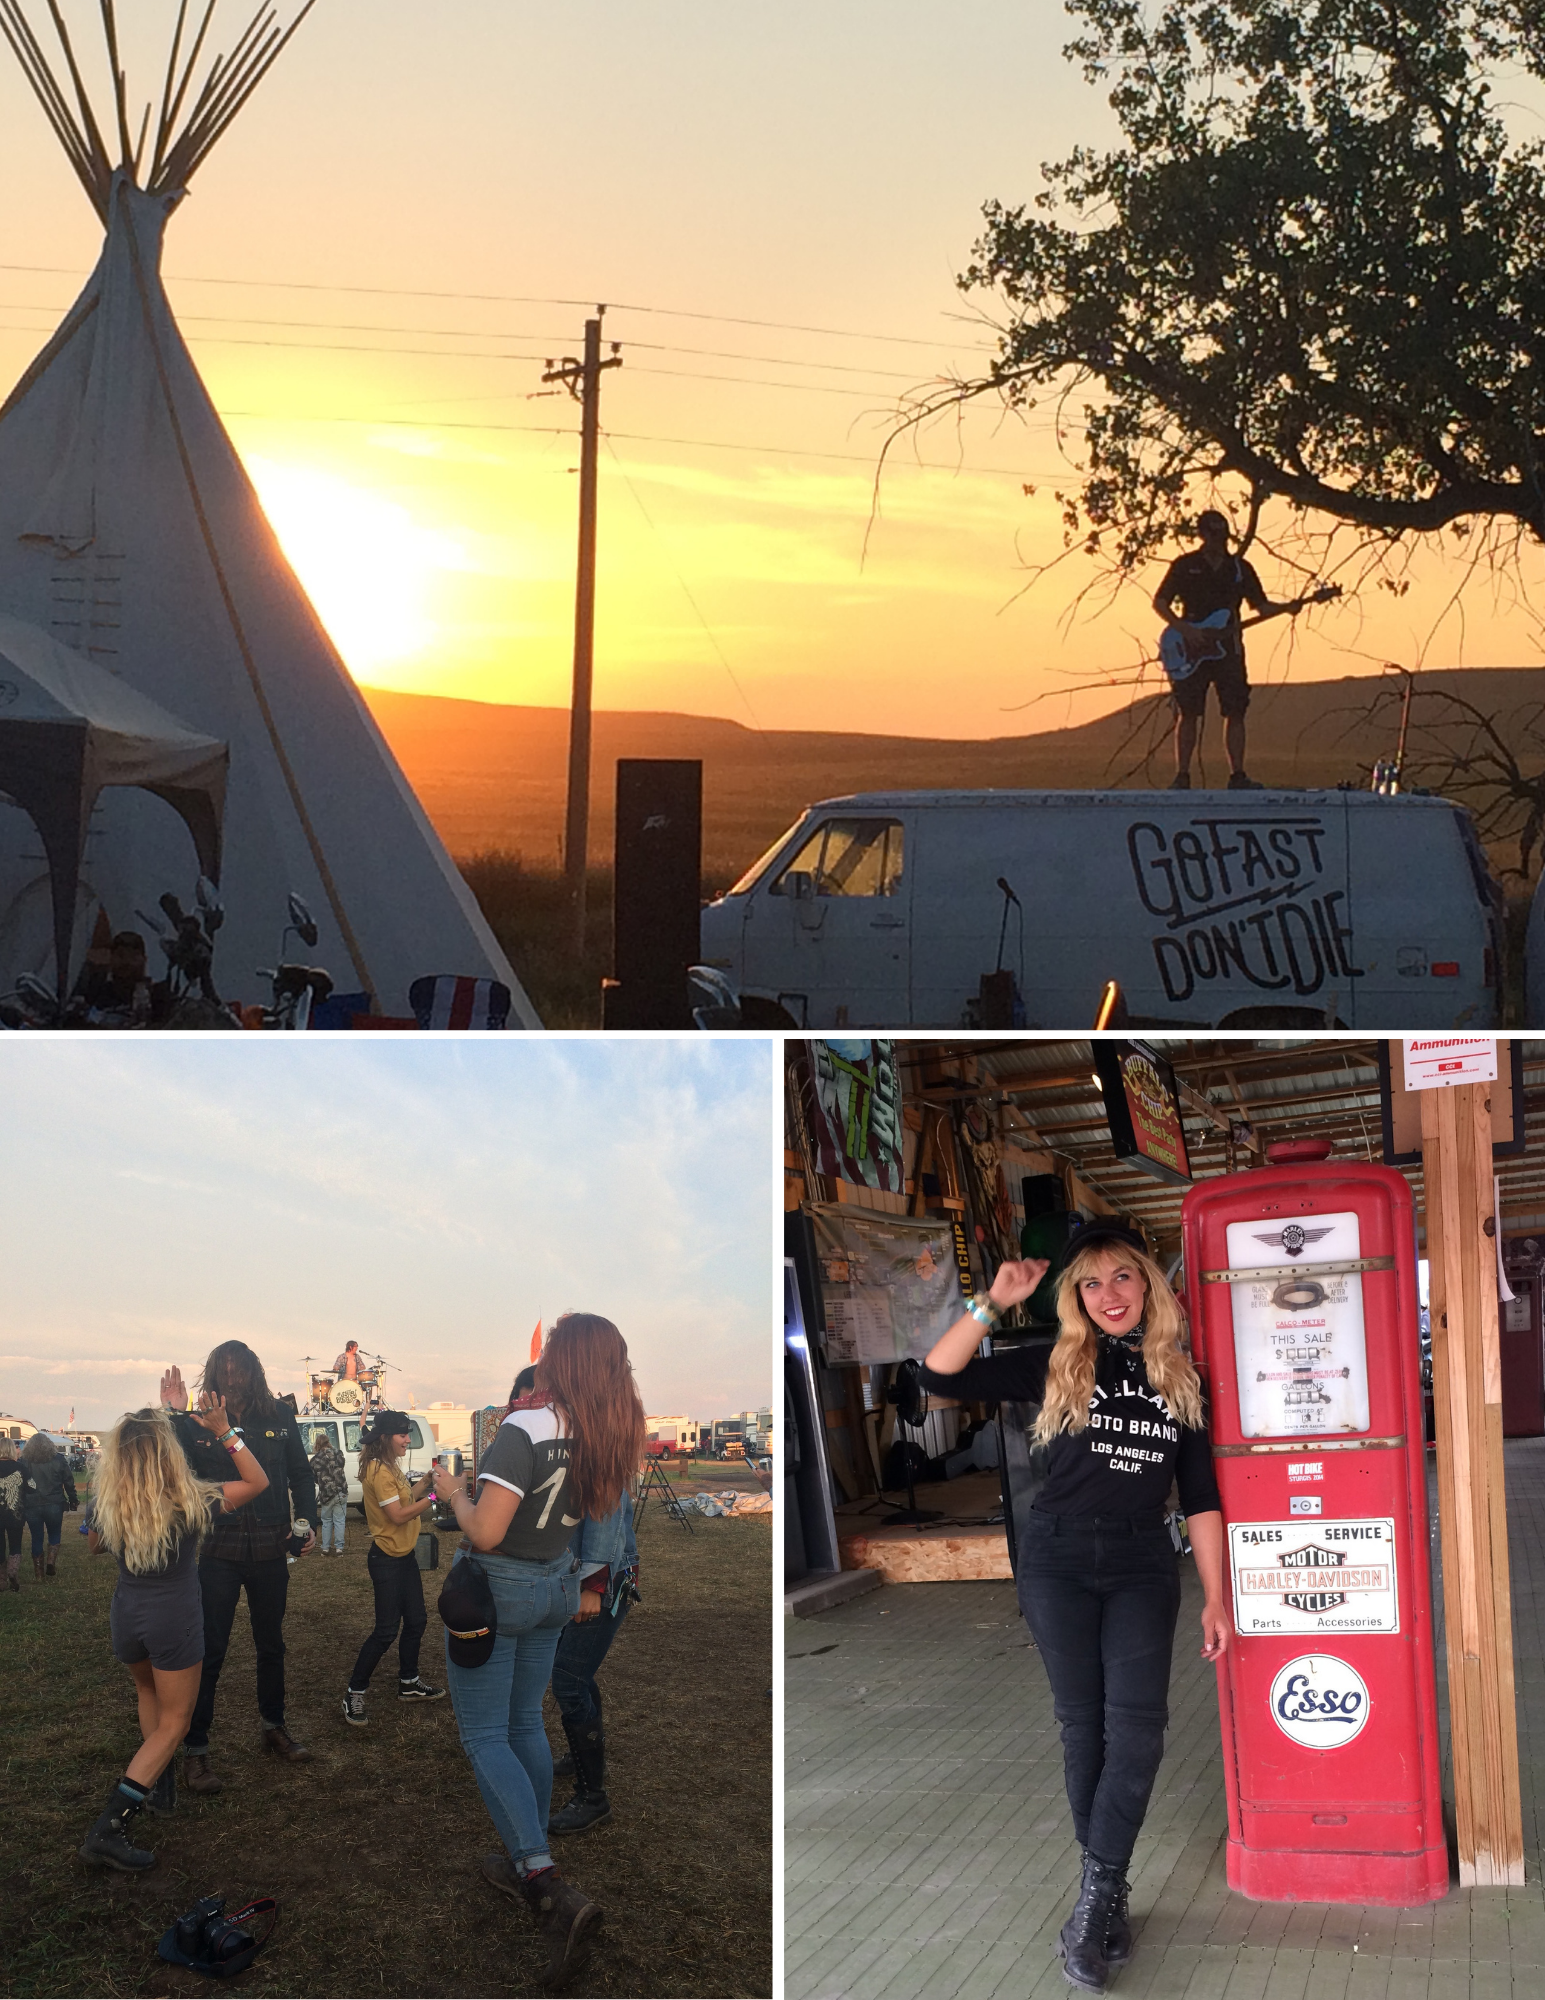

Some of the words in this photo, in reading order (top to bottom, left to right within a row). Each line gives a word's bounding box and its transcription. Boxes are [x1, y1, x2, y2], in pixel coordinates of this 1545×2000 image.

[1125, 1054, 1169, 1103] BUFFALO
[1140, 1090, 1163, 1120] CHIP
[1136, 1110, 1149, 1132] The
[1148, 1118, 1162, 1139] Best
[1161, 1127, 1177, 1151] Party
[954, 1224, 970, 1267] CHIP
[959, 1273, 975, 1299] LO
[1327, 1281, 1342, 1289] BEFORE
[1258, 1300, 1270, 1308] FULL
[1328, 1296, 1349, 1304] DELIVERY
[1270, 1334, 1296, 1345] THIS
[1304, 1332, 1333, 1344] SALE
[1281, 1382, 1325, 1391] GALLONS
[1086, 1413, 1123, 1432] OTO
[1129, 1420, 1178, 1443] BRAND
[1091, 1441, 1113, 1455] LOS
[1115, 1445, 1164, 1463] ANGELES
[1109, 1458, 1143, 1475] CALIF.
[1288, 1463, 1303, 1475] HOT
[1304, 1462, 1323, 1474] BIKE
[1241, 1530, 1283, 1543] SALES
[1325, 1527, 1382, 1541] SERVICE
[1284, 1550, 1339, 1567] MOTOR
[1247, 1570, 1382, 1590] HARLEY-DAVIDSON
[1287, 1593, 1342, 1612] CYCLES
[1252, 1617, 1282, 1629] Parts
[1317, 1616, 1382, 1628] Accessories
[1278, 1674, 1362, 1722] Esso
